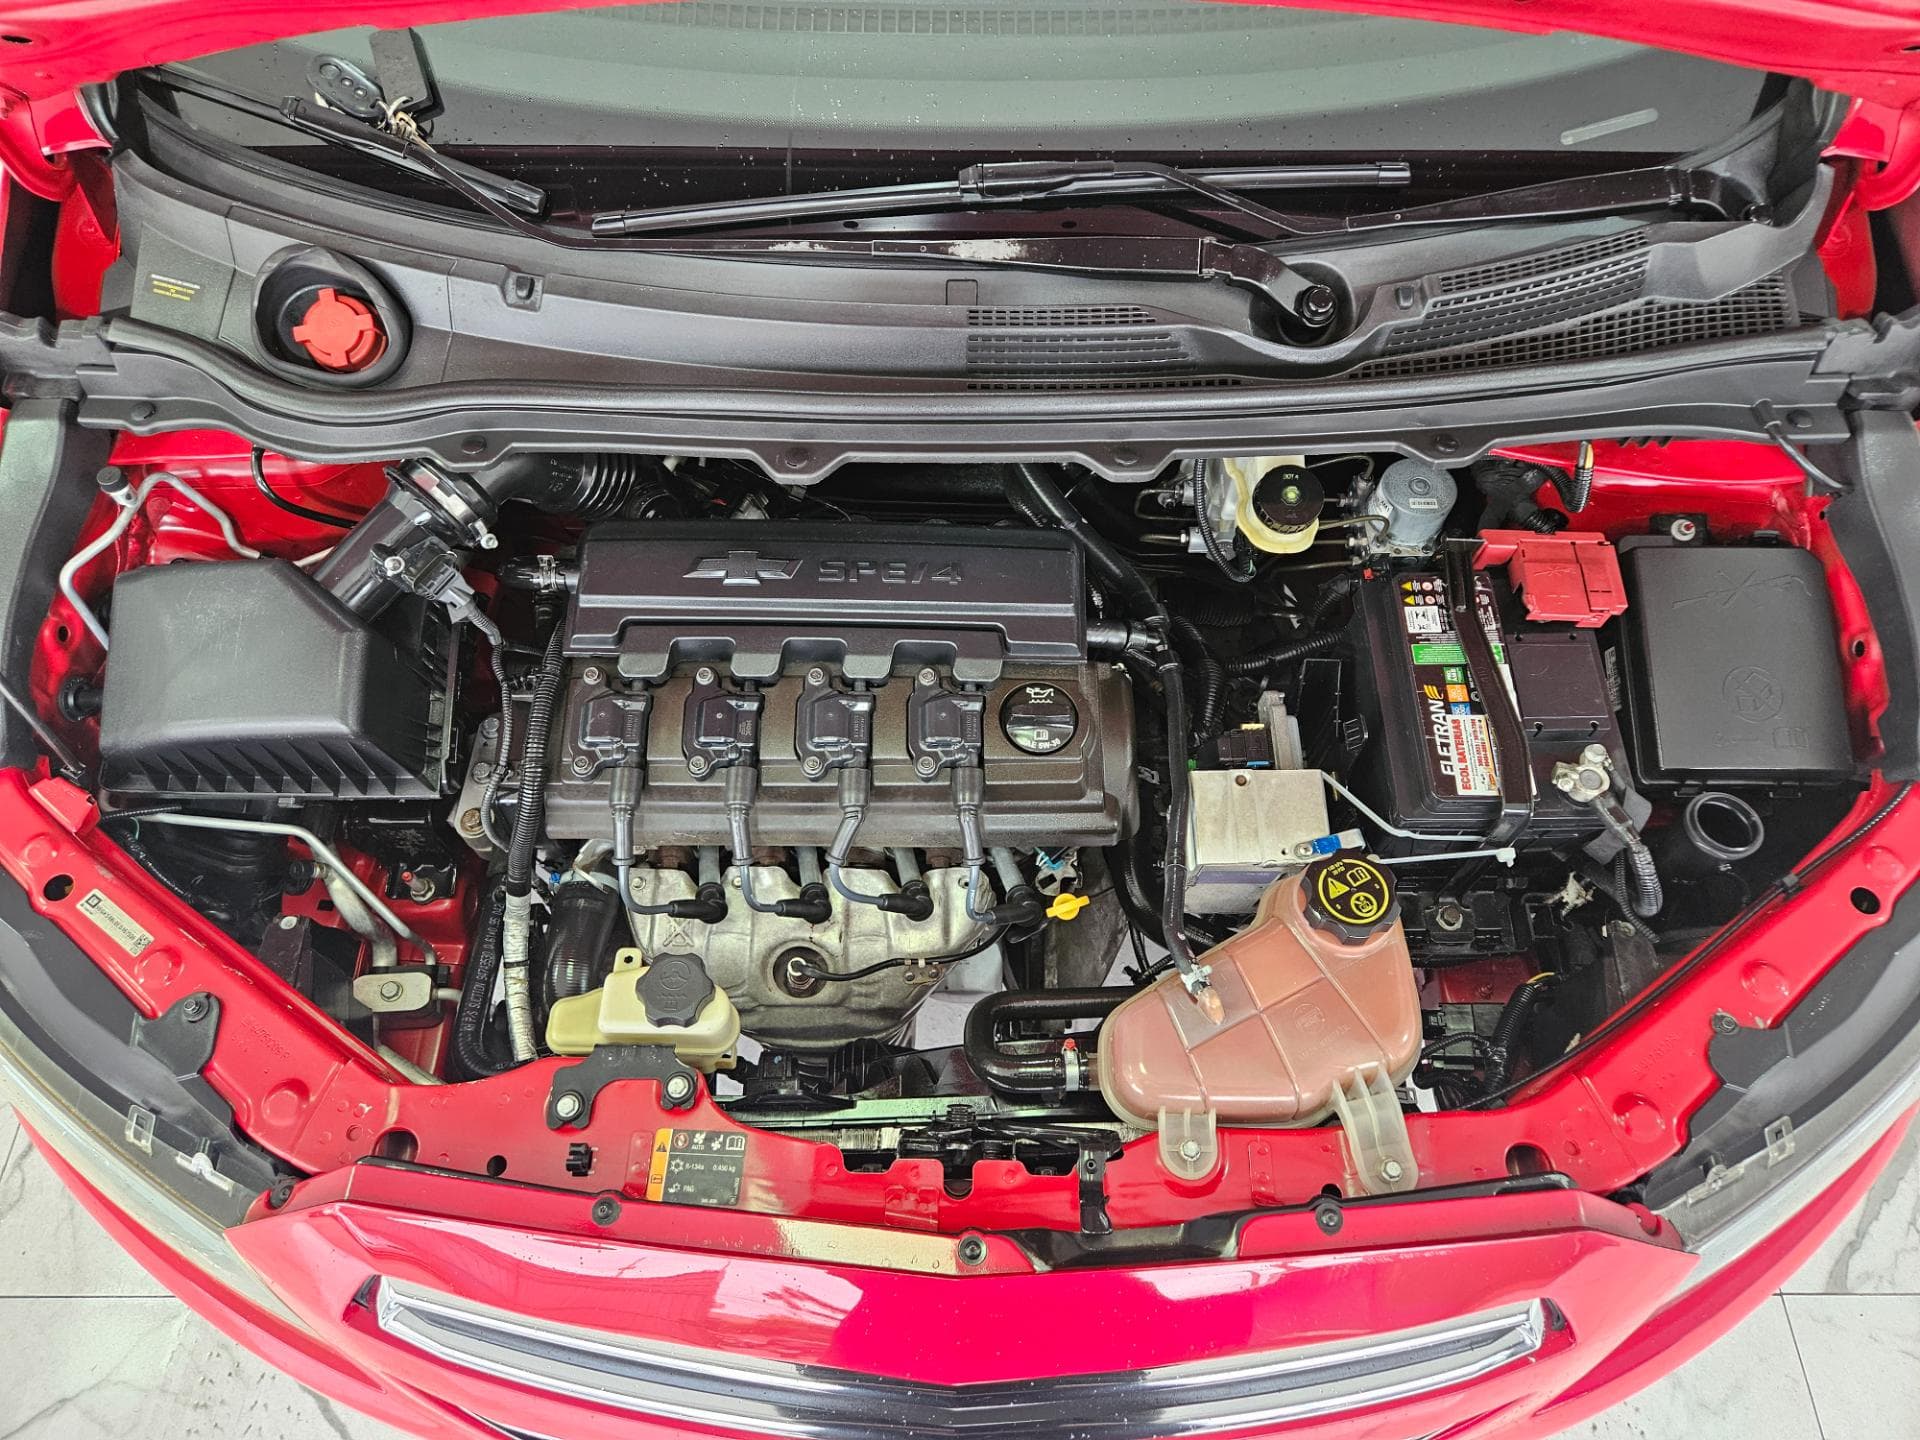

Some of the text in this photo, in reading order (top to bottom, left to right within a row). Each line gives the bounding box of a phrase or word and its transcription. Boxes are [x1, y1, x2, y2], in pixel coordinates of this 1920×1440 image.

[817, 559, 963, 585] SPE/4
[1451, 719, 1467, 763] BATERIAS
[1459, 765, 1472, 790] ECOL
